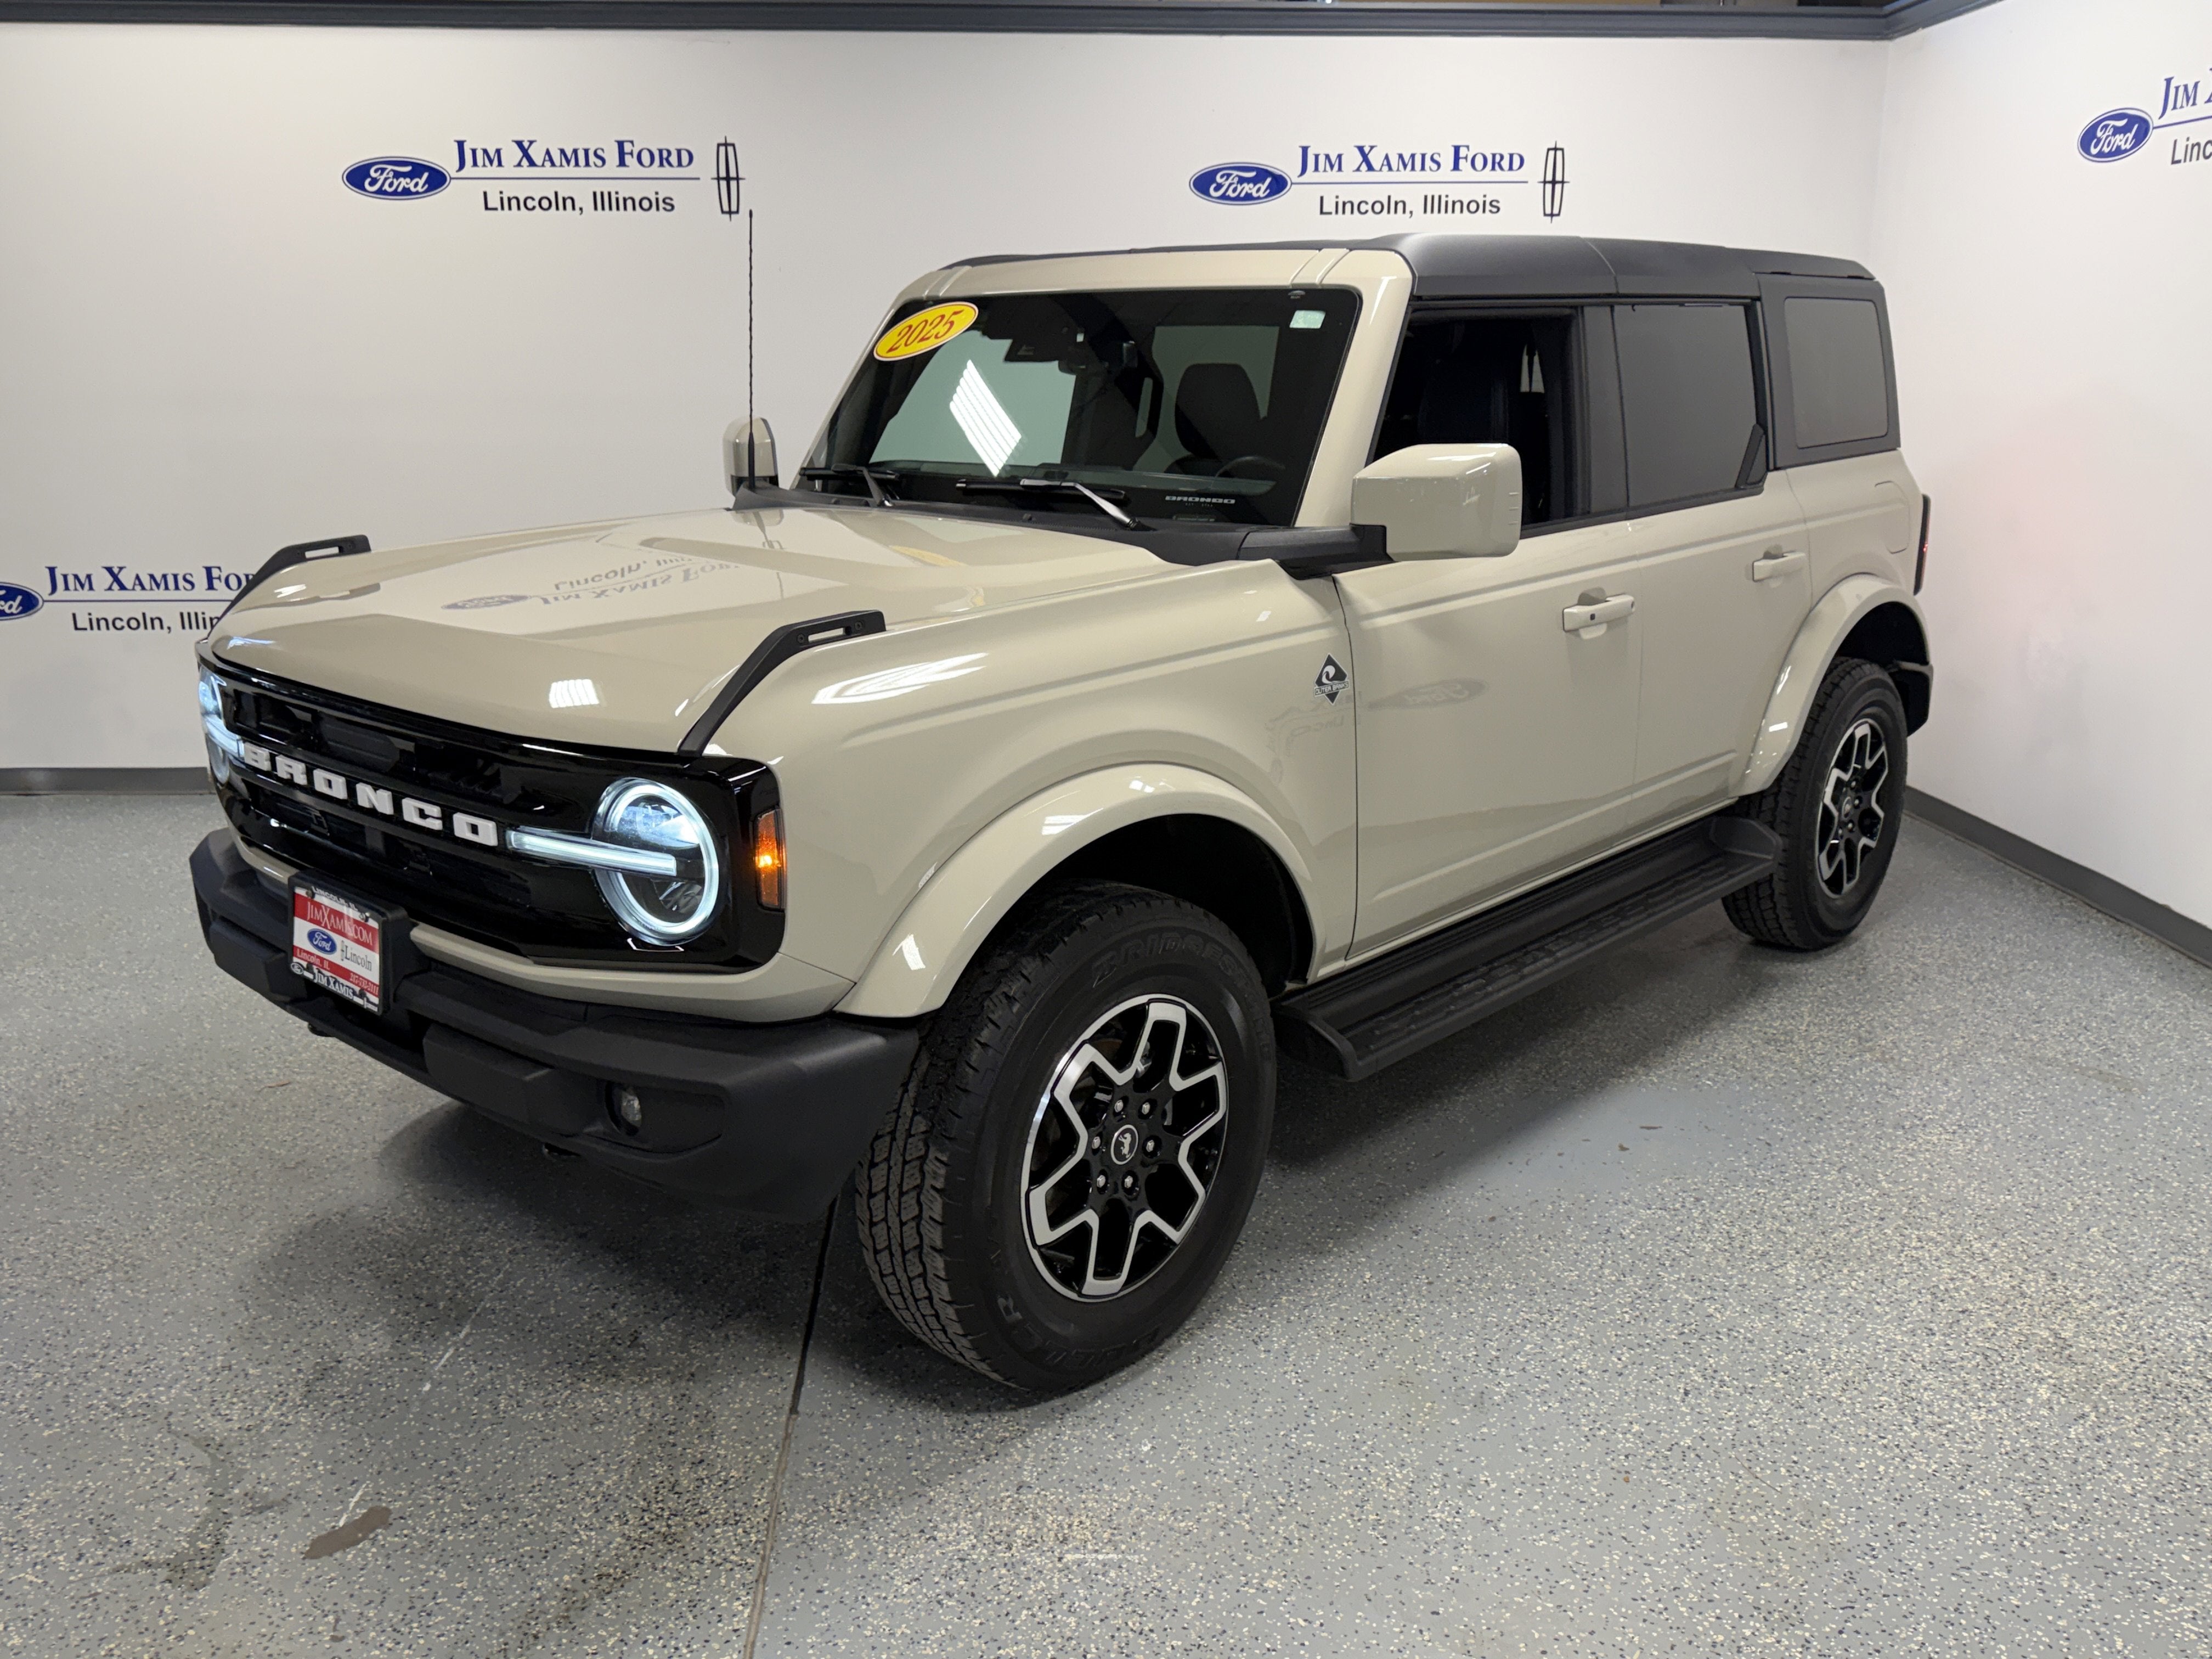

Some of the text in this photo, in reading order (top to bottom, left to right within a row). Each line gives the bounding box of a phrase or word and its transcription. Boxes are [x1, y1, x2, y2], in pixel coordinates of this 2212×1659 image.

[2158, 76, 2201, 120] JIM
[2090, 118, 2139, 155] Ford
[453, 139, 695, 173] JIM XAMIS FORD
[1297, 144, 1525, 178] JIM XAMIS FORD
[364, 163, 428, 194] Ford
[1209, 169, 1270, 199] Ford
[483, 190, 675, 215] Lincoln, Illinois
[1318, 193, 1501, 218] Lincoln, Illinois
[885, 309, 964, 354] 2025
[1165, 495, 1235, 504] BRONCO
[46, 566, 95, 596] JIM
[101, 566, 195, 591] XAMIS
[71, 612, 172, 634] Lincoln,
[1314, 681, 1348, 695] OUTER BANKS
[244, 742, 499, 847] BRONCO
[313, 932, 332, 951] Ford
[296, 948, 322, 967] Lincoln,
[345, 945, 373, 972] Lincoln
[313, 969, 354, 1000] JIM XAMIS
